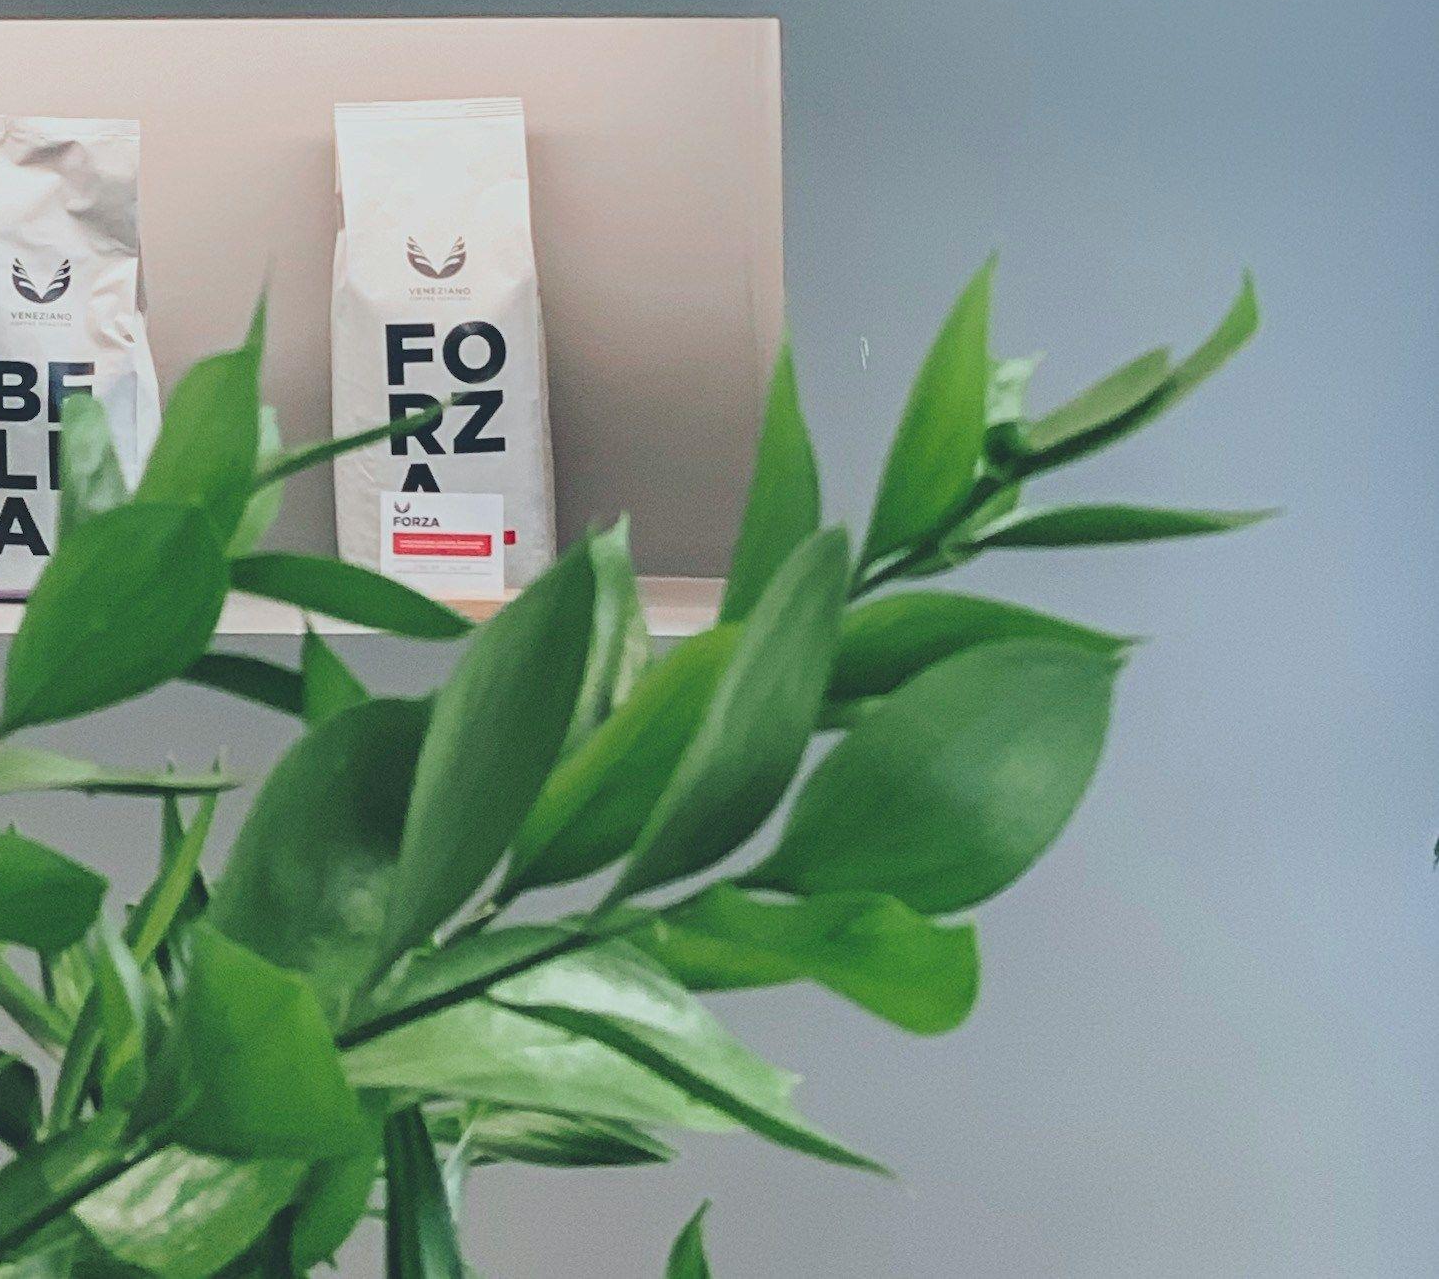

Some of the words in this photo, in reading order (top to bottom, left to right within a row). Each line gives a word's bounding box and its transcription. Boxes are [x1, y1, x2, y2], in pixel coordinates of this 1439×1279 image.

[408, 288, 470, 296] VENEZIANO
[11, 312, 72, 320] VENEZIANO
[385, 321, 506, 386] FO
[389, 390, 506, 456] RZ
[393, 516, 440, 527] FORZA
